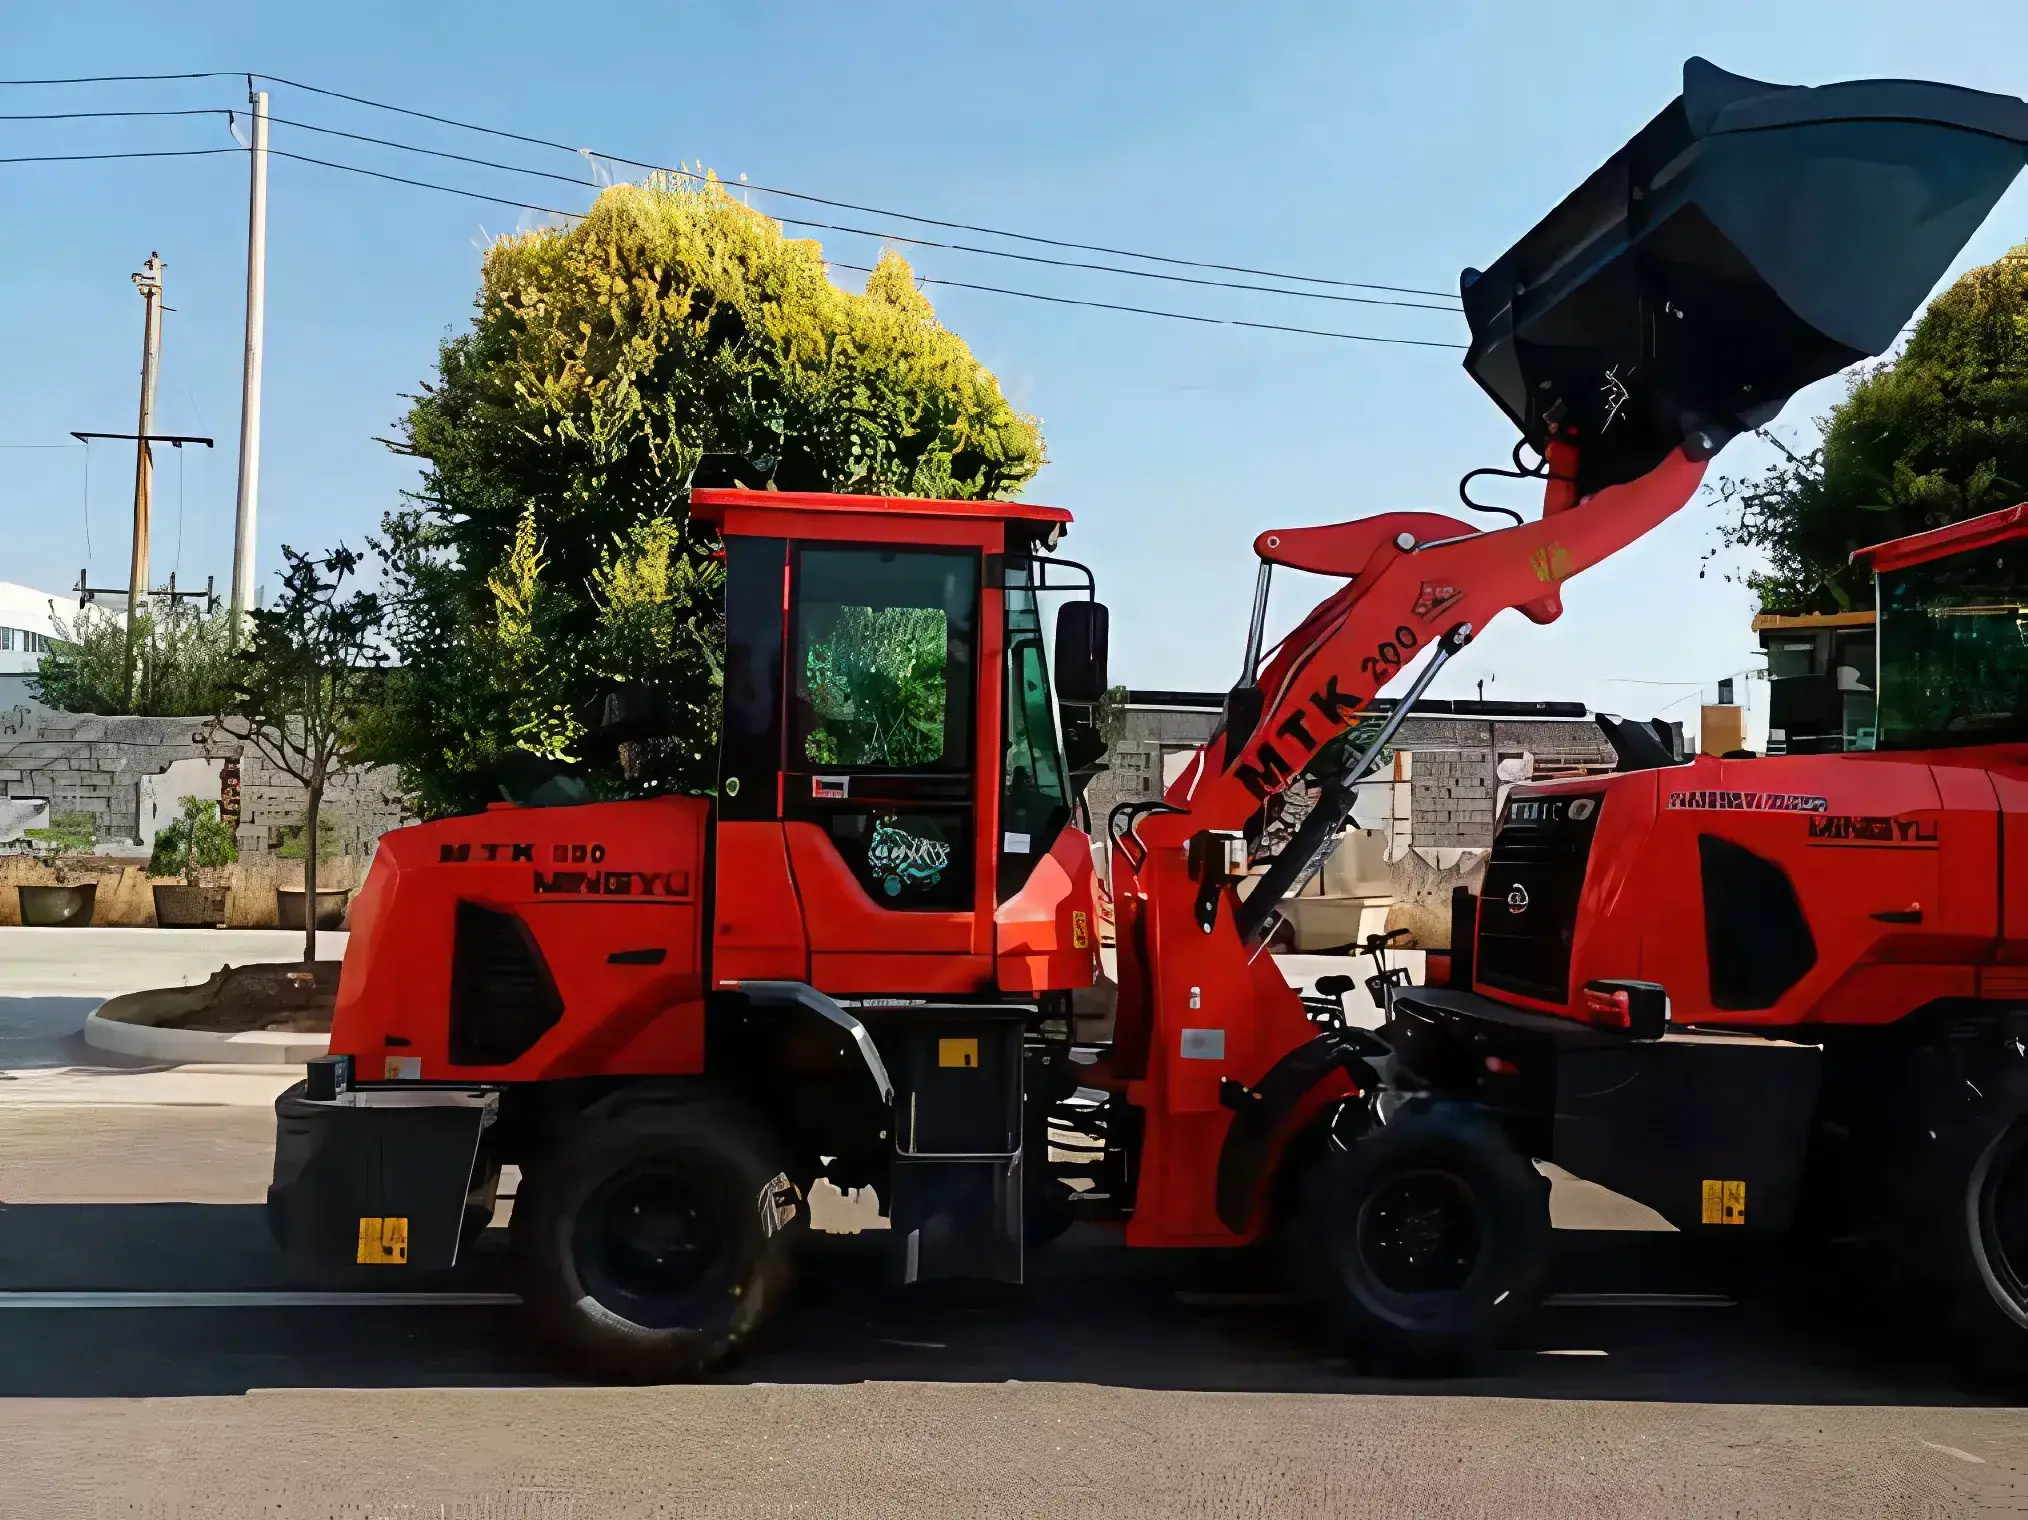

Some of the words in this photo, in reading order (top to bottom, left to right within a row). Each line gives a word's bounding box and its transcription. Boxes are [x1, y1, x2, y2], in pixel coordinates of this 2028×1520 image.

[1235, 675, 1363, 800] MTK
[1361, 625, 1418, 684] 200
[439, 844, 535, 863] MTK
[534, 870, 689, 896] MNYU
